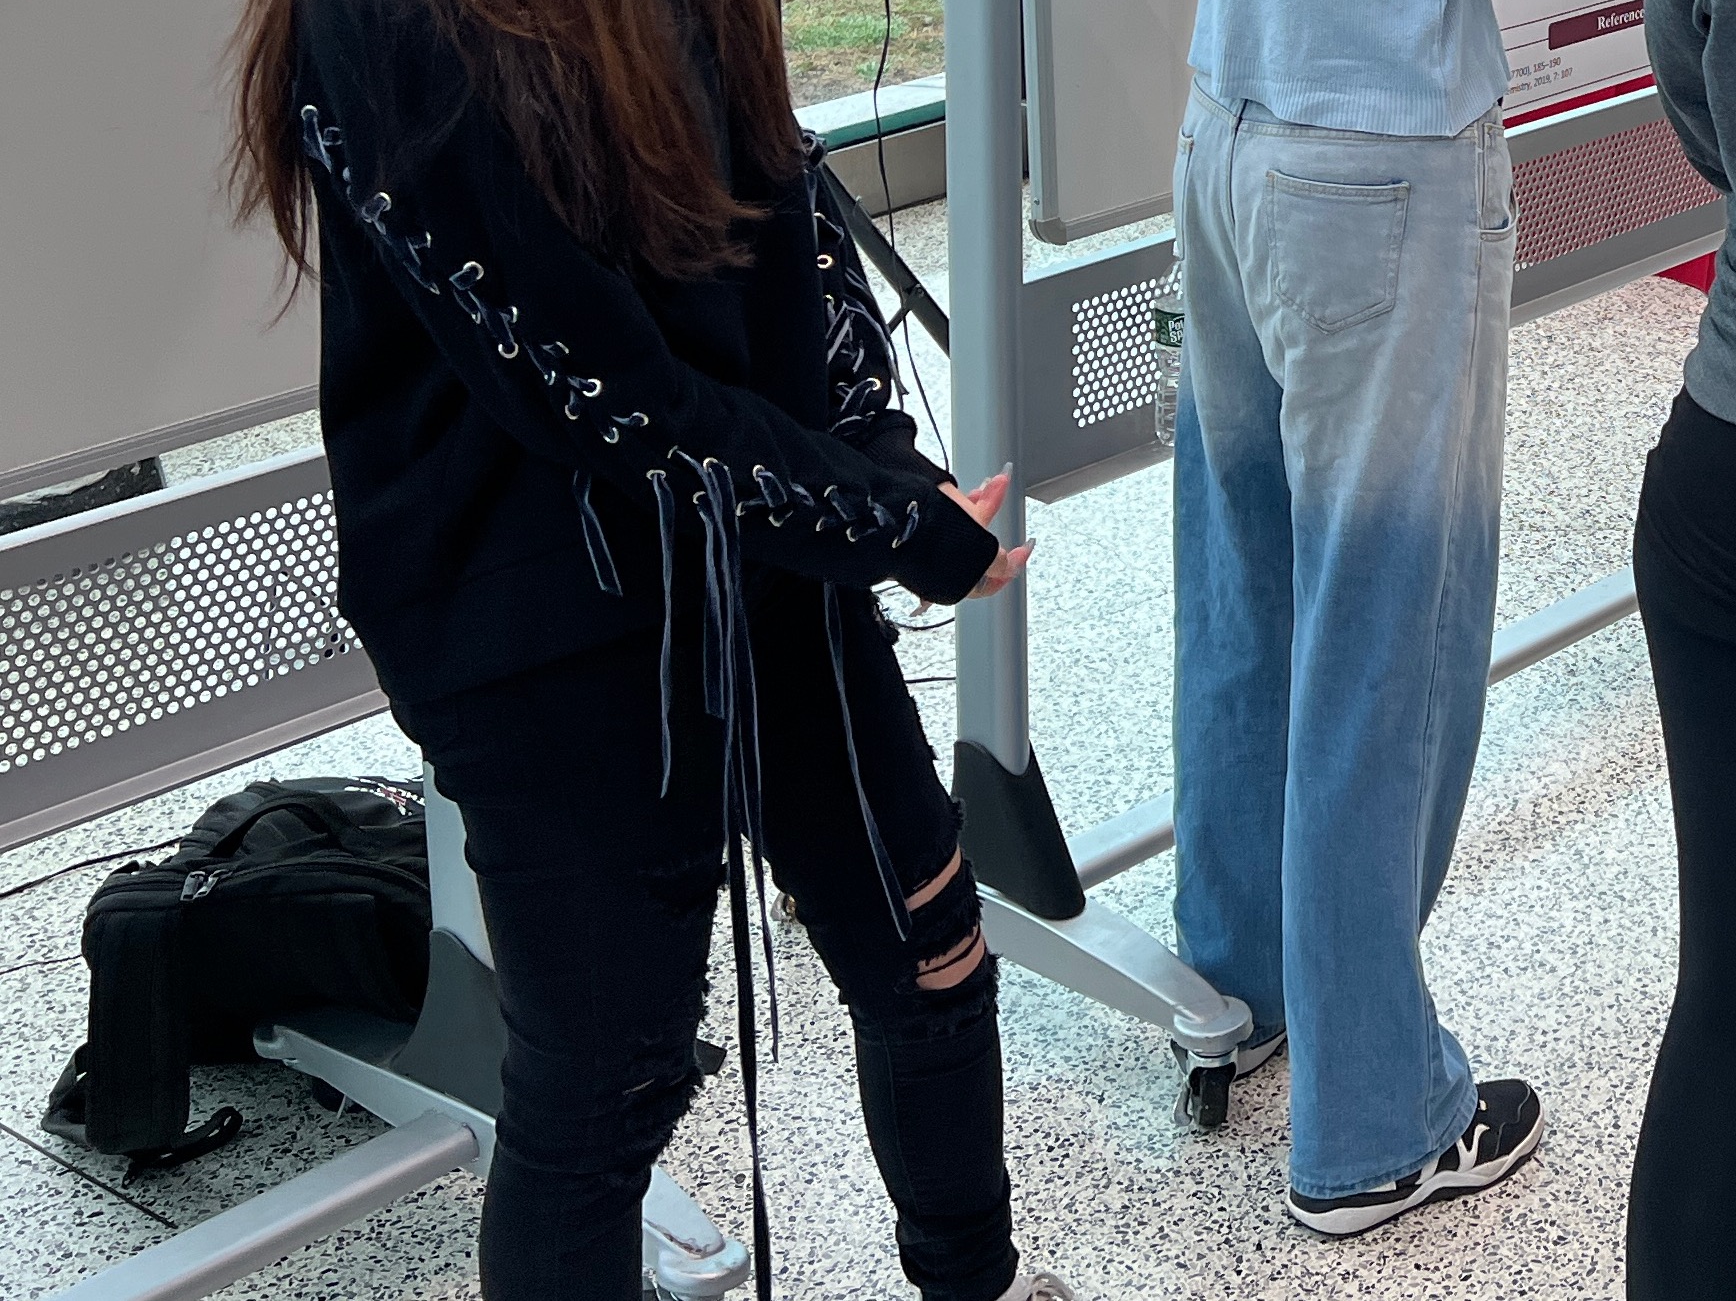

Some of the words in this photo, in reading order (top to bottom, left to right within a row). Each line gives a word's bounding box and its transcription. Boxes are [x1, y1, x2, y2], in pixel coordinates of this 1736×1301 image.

[1597, 7, 1644, 28] Reference
[1534, 74, 1551, 87] 2019,
[1561, 68, 1572, 80] 107
[1168, 320, 1184, 331] Pol
[1170, 330, 1183, 343] SP
